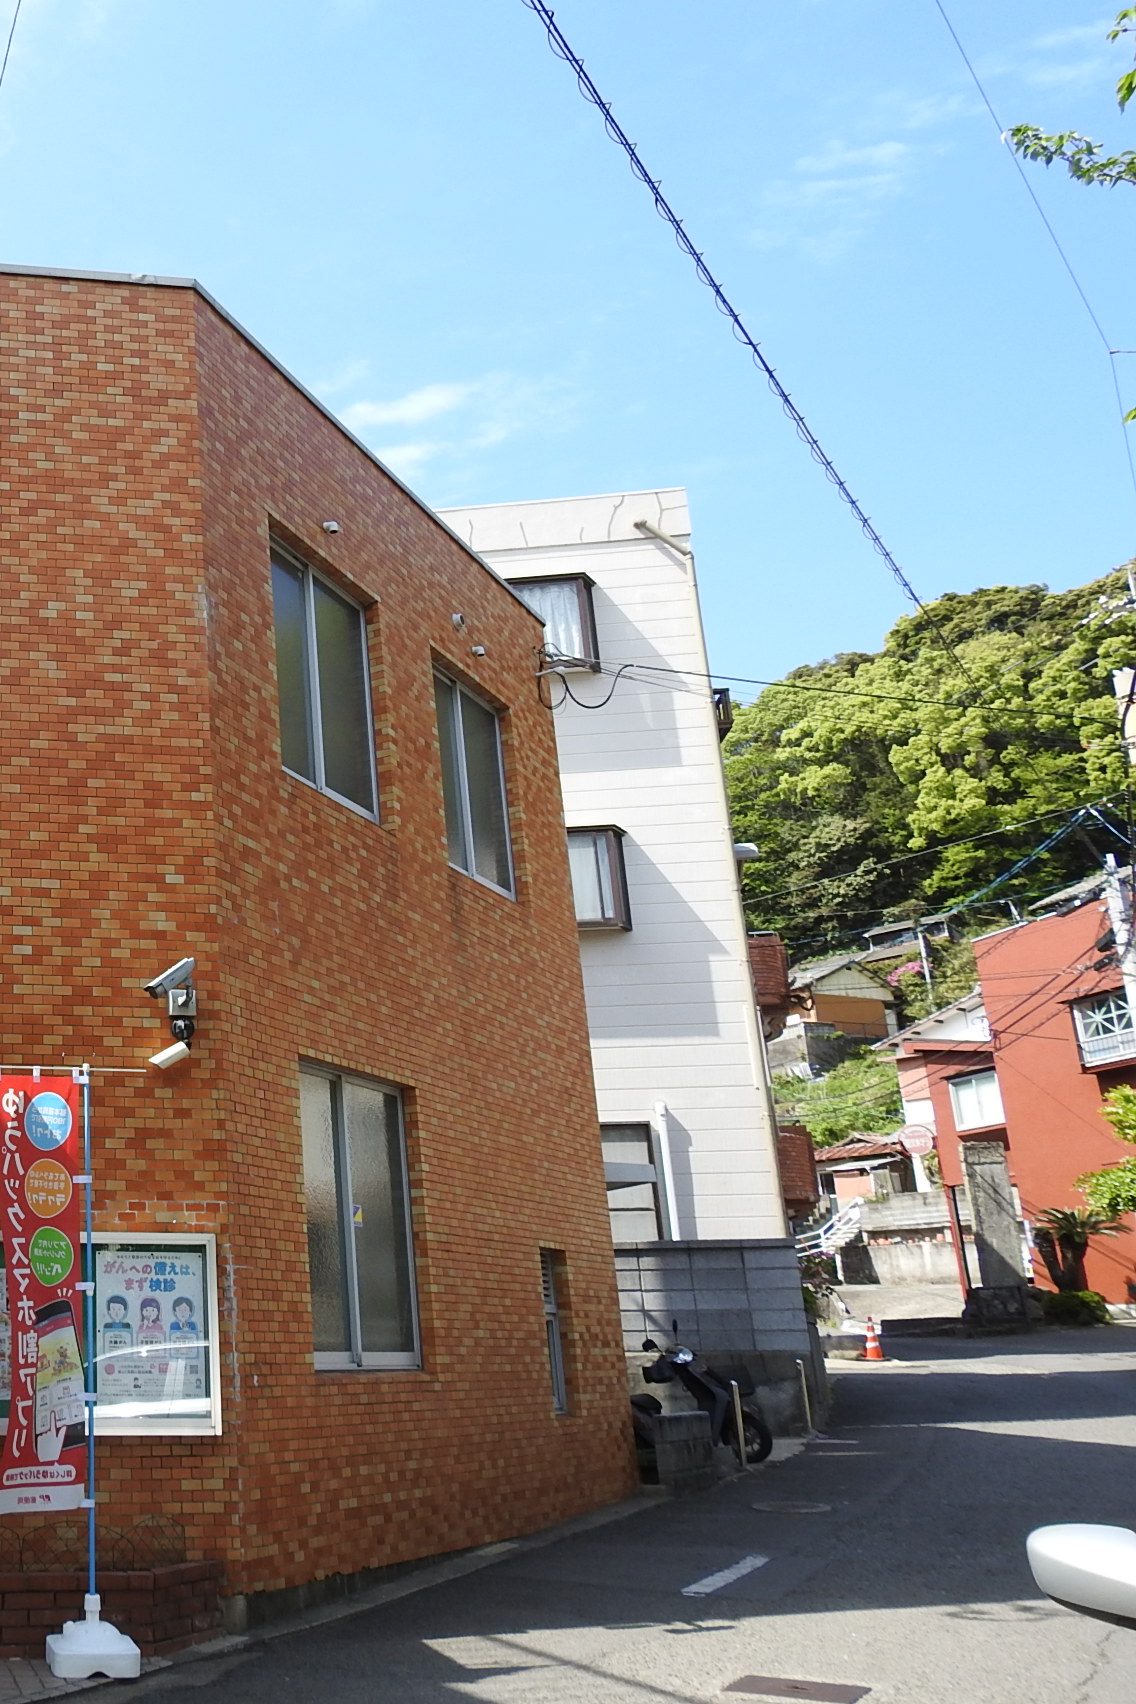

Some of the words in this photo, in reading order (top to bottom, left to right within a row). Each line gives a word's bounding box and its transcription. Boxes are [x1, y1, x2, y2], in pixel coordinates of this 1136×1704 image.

[103, 1260, 196, 1277] がんへの備えは、
[124, 1277, 177, 1292] まず検診
